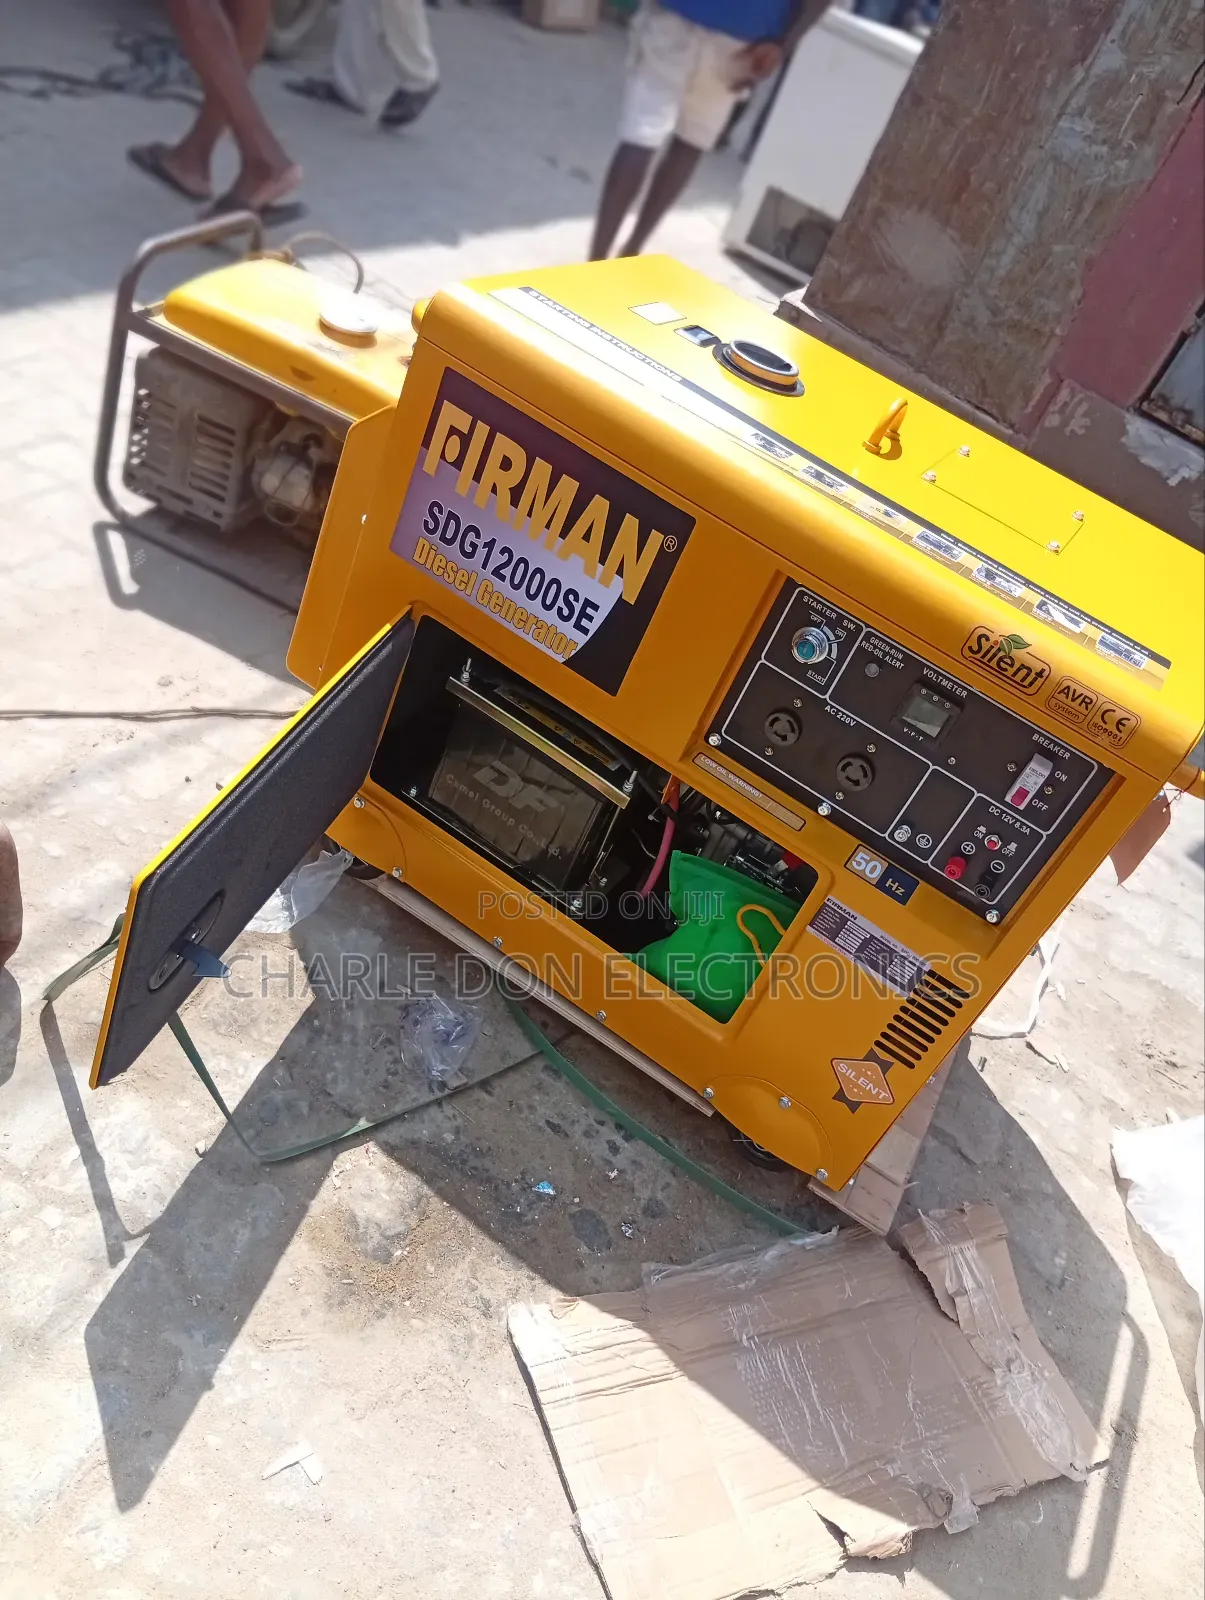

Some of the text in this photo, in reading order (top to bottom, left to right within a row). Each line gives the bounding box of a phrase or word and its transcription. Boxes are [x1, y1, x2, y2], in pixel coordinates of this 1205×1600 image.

[422, 400, 665, 606] FIRMAN
[422, 499, 600, 636] SDG12000SE
[412, 536, 579, 660] Diesel Generator
[803, 595, 856, 632] STARTER SW.
[810, 615, 822, 624] OFF
[835, 629, 844, 638] ON
[869, 637, 904, 660] GREEN-RUN
[884, 654, 905, 670] ALERT
[967, 632, 1048, 690] Silent
[807, 669, 825, 684] START
[922, 667, 968, 699] VOLTMETER
[1057, 684, 1094, 711] AVR
[824, 705, 857, 727] AC 220V
[1053, 702, 1080, 721] system
[1031, 732, 1071, 761] BREAKER
[700, 755, 718, 769] LOW
[716, 766, 727, 777] OIL
[728, 773, 763, 799] WARNING!
[1054, 770, 1068, 782] ON
[444, 773, 480, 803] Camel
[482, 799, 515, 828] Group
[1031, 798, 1049, 812] OFF
[988, 805, 1001, 816] DC
[1001, 811, 1016, 825] 12V
[973, 829, 984, 839] ON
[1001, 846, 1015, 857] OFF
[851, 851, 882, 879] 50
[885, 878, 906, 897] Hz
[826, 897, 858, 921] FIRMAN
[837, 1063, 889, 1100] SILENT
